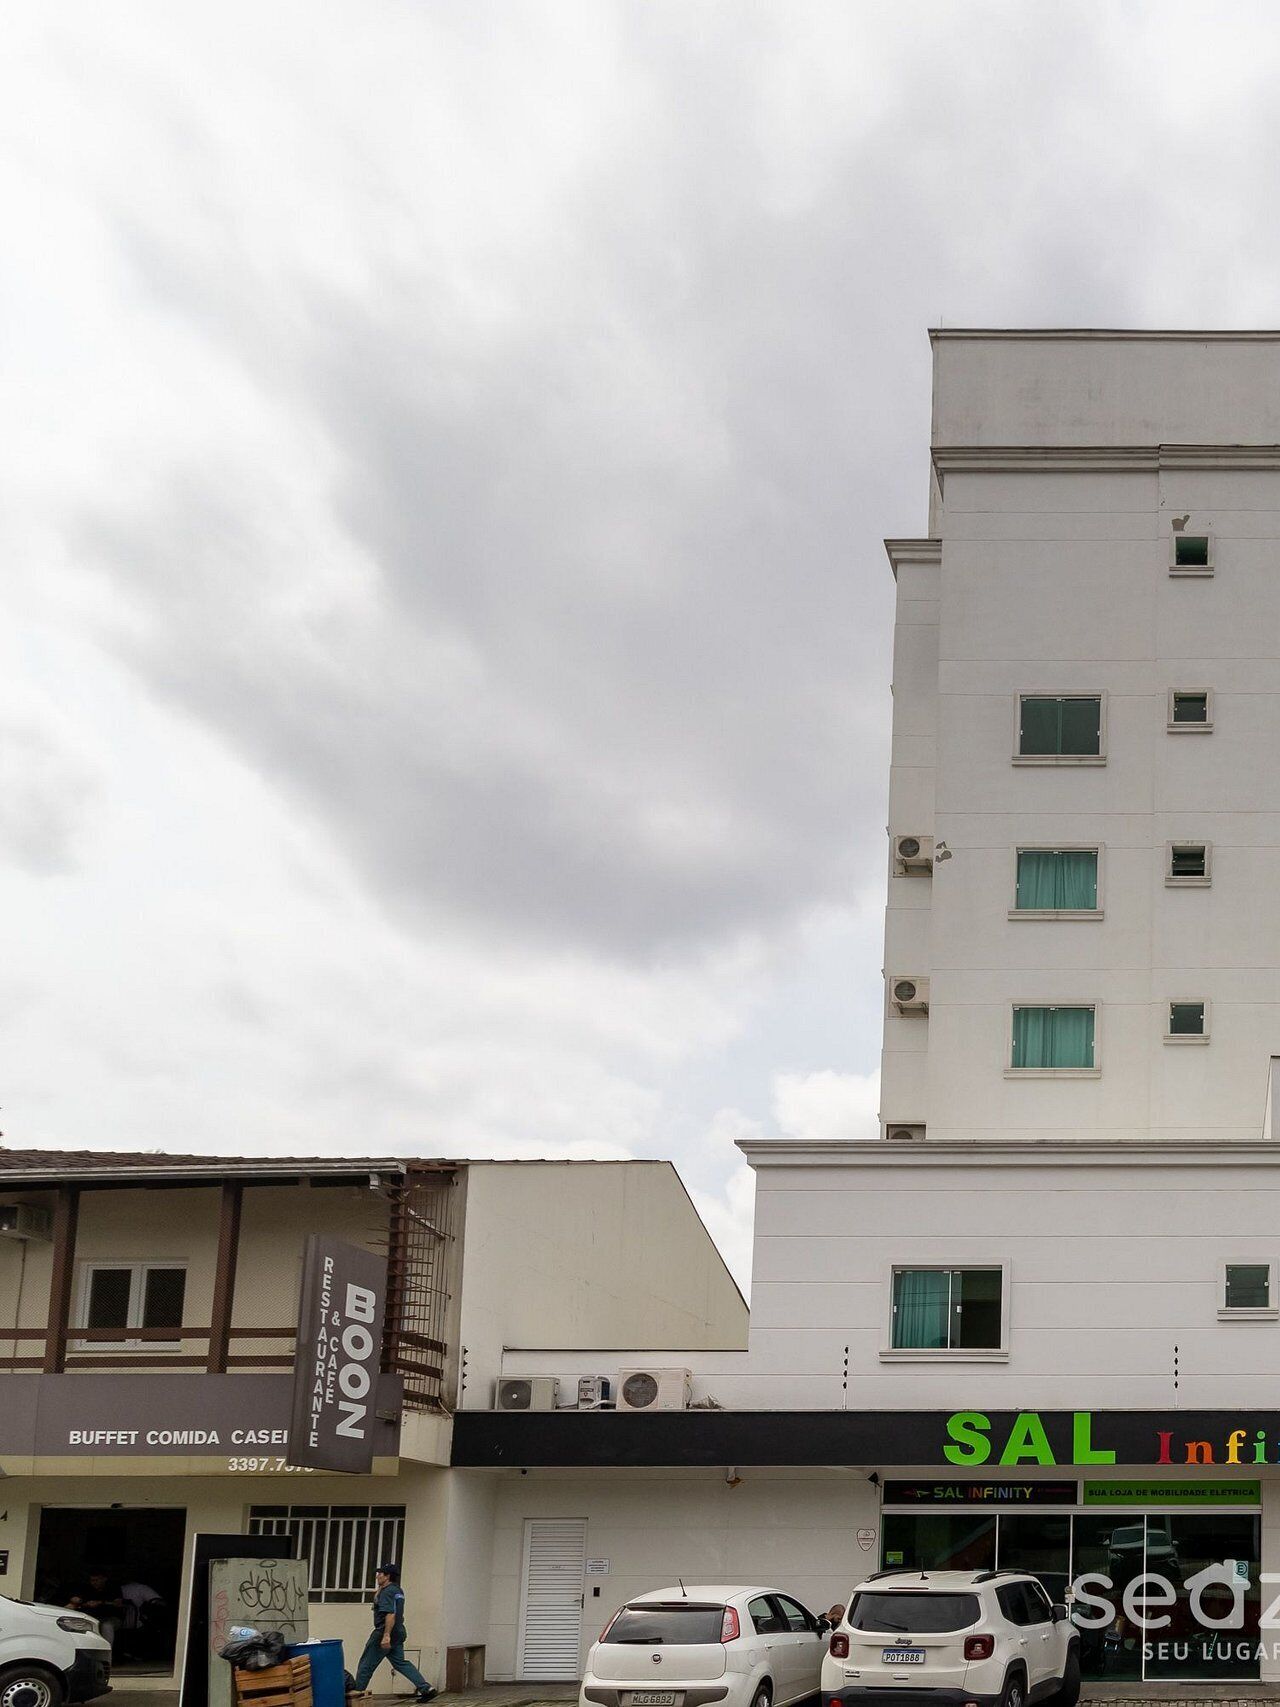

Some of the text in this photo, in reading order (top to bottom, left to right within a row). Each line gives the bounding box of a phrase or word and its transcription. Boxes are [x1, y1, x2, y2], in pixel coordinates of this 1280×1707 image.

[309, 1256, 334, 1448] RESTAURANTE
[325, 1310, 341, 1404] & CAFÉ
[335, 1283, 376, 1439] BOOZ
[69, 1430, 288, 1445] BUFFET COMIDA CASEI
[943, 1412, 1116, 1466] SAL
[933, 1487, 964, 1499] SAL
[968, 1487, 1034, 1499] INFINITY
[1088, 1489, 1107, 1497] SUA
[1110, 1489, 1134, 1497] LOJA
[1136, 1489, 1148, 1497] DE
[1150, 1489, 1208, 1497] MOBILIDADE
